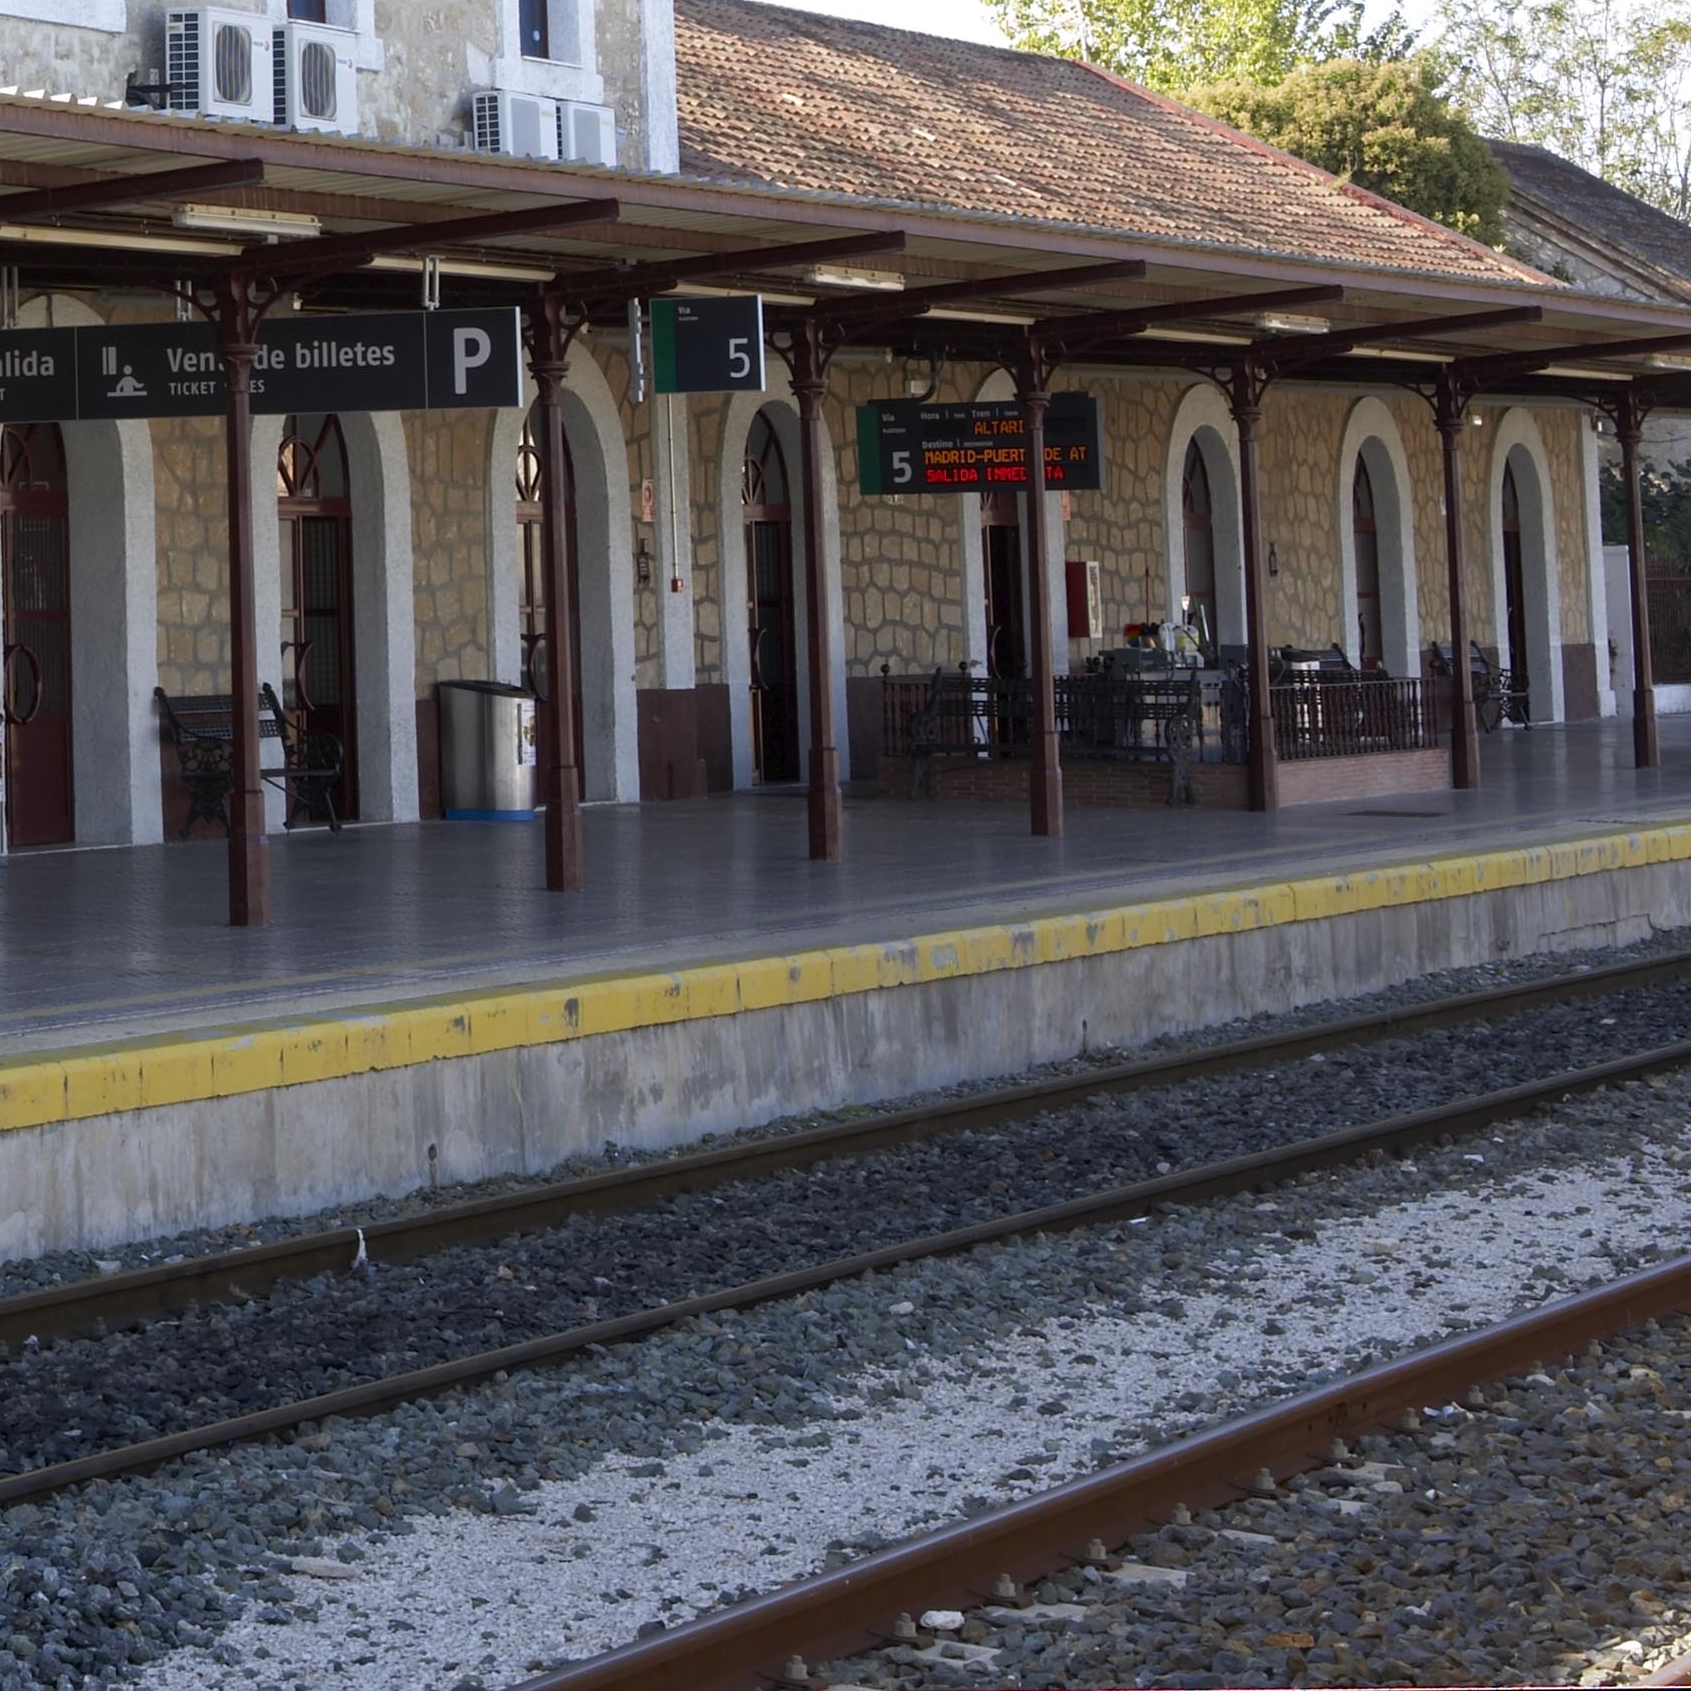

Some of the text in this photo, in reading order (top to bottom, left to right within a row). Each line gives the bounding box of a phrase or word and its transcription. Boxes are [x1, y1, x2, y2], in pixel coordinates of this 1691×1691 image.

[166, 340, 396, 373] Ven de billetes
[453, 327, 492, 395] P
[729, 337, 751, 379] 5
[169, 381, 217, 396] TICKET
[921, 412, 940, 421] Hora
[974, 420, 1024, 435] ALTARI
[925, 445, 1087, 465] MADRID-PUERT DE AT
[892, 450, 913, 484] 5
[926, 465, 1064, 484] SALIDA INMEDTA
